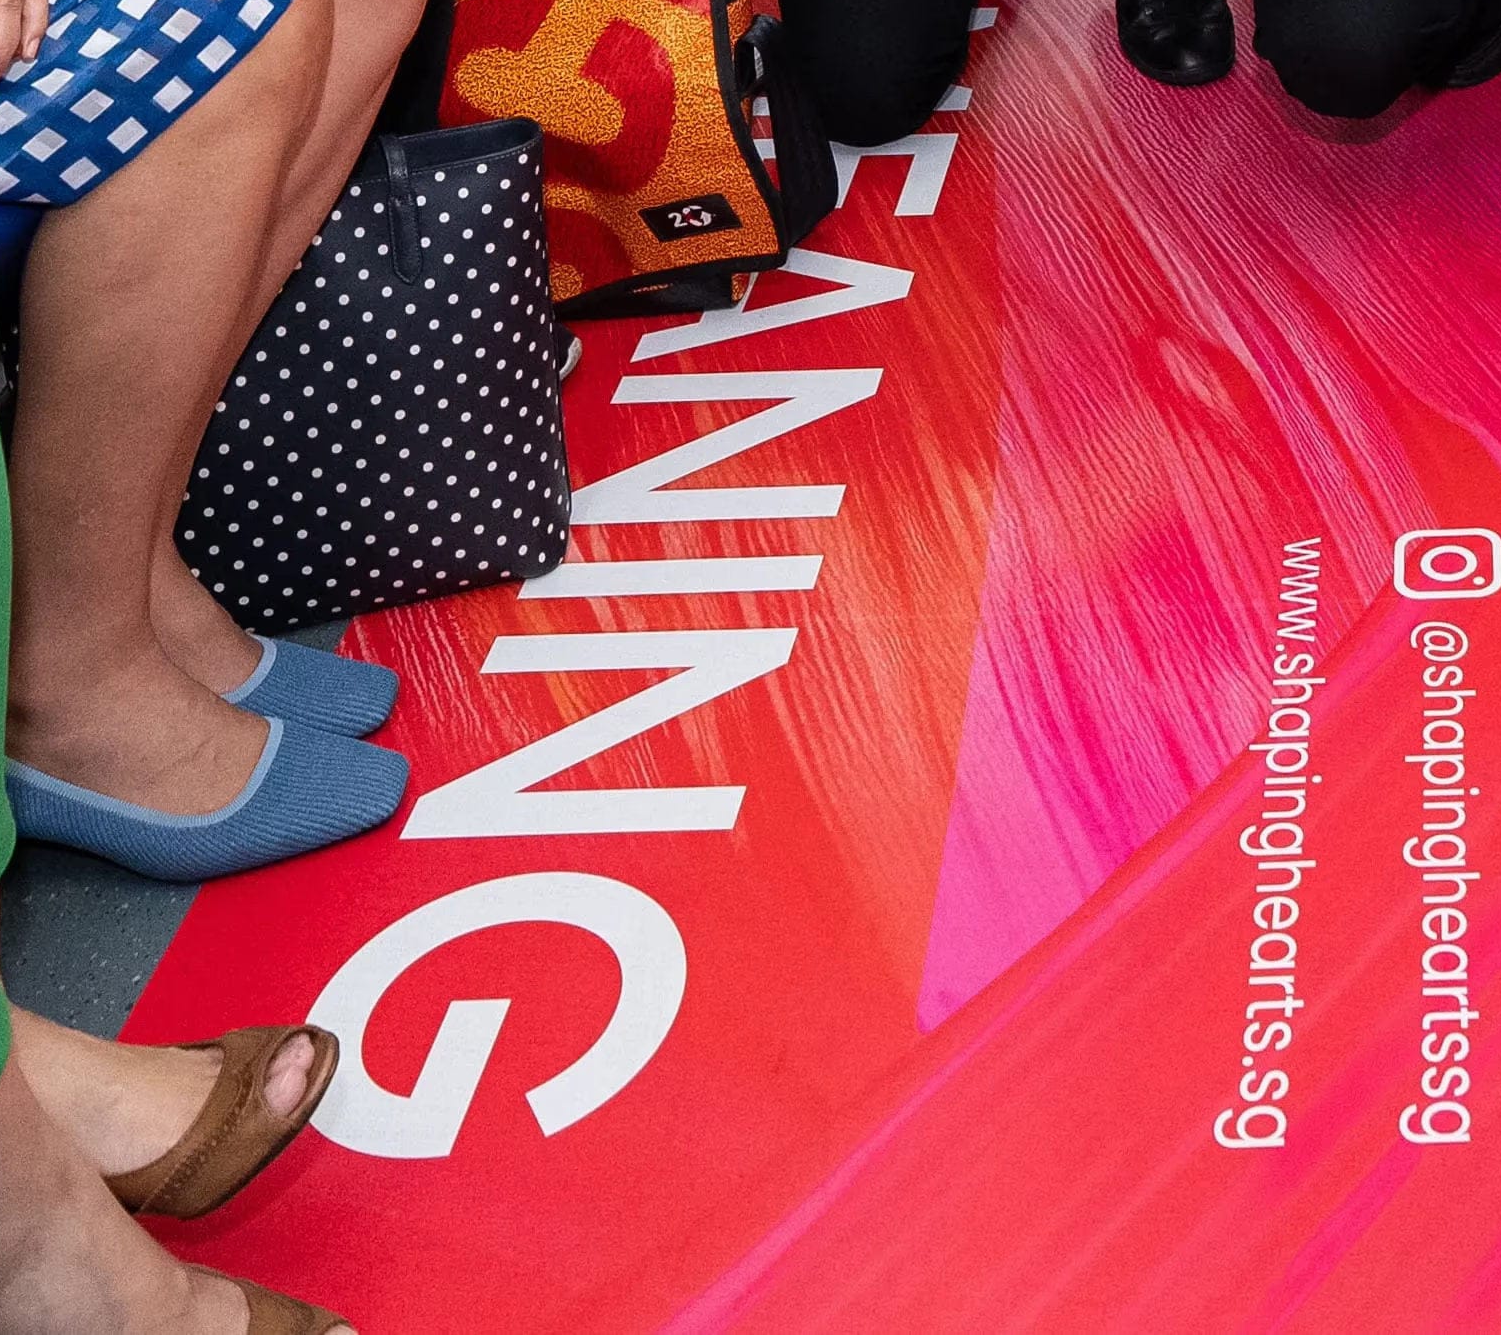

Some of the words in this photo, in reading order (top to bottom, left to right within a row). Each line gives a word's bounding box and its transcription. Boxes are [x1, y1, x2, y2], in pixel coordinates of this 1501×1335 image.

[306, 8, 998, 1159] EANING
[1213, 536, 1322, 1149] www.shapinghearts.sg
[1399, 620, 1481, 1144] @shapingheartssg
